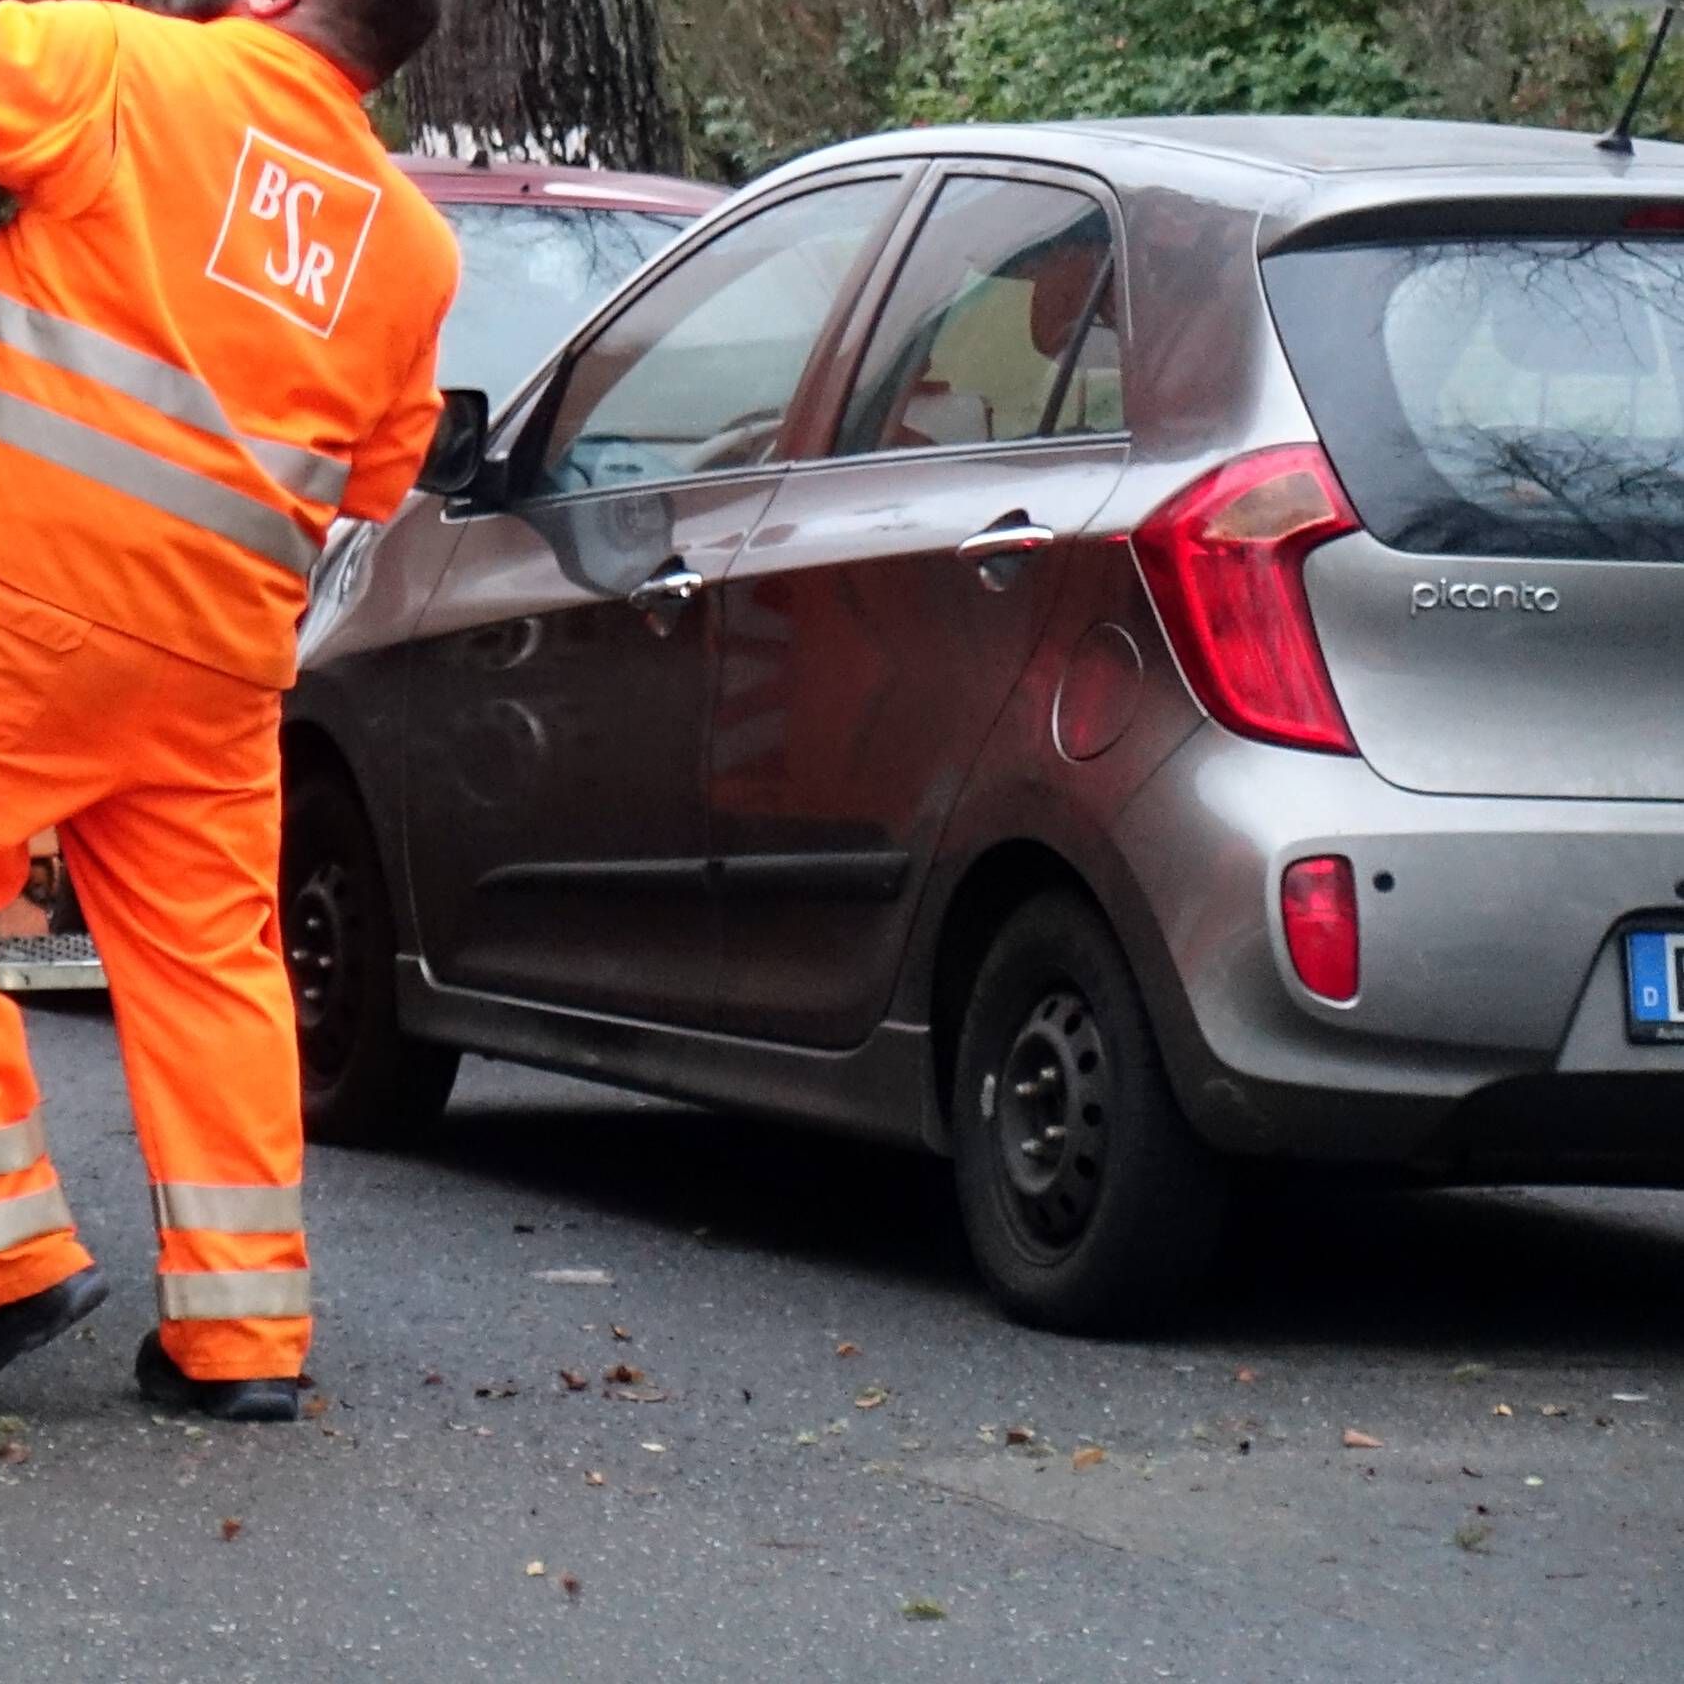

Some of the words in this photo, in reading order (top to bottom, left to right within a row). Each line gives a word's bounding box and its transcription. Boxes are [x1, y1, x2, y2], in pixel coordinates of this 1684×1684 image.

[249, 160, 336, 307] BSR
[1410, 576, 1561, 615] picanto
[1643, 985, 1660, 1008] D
